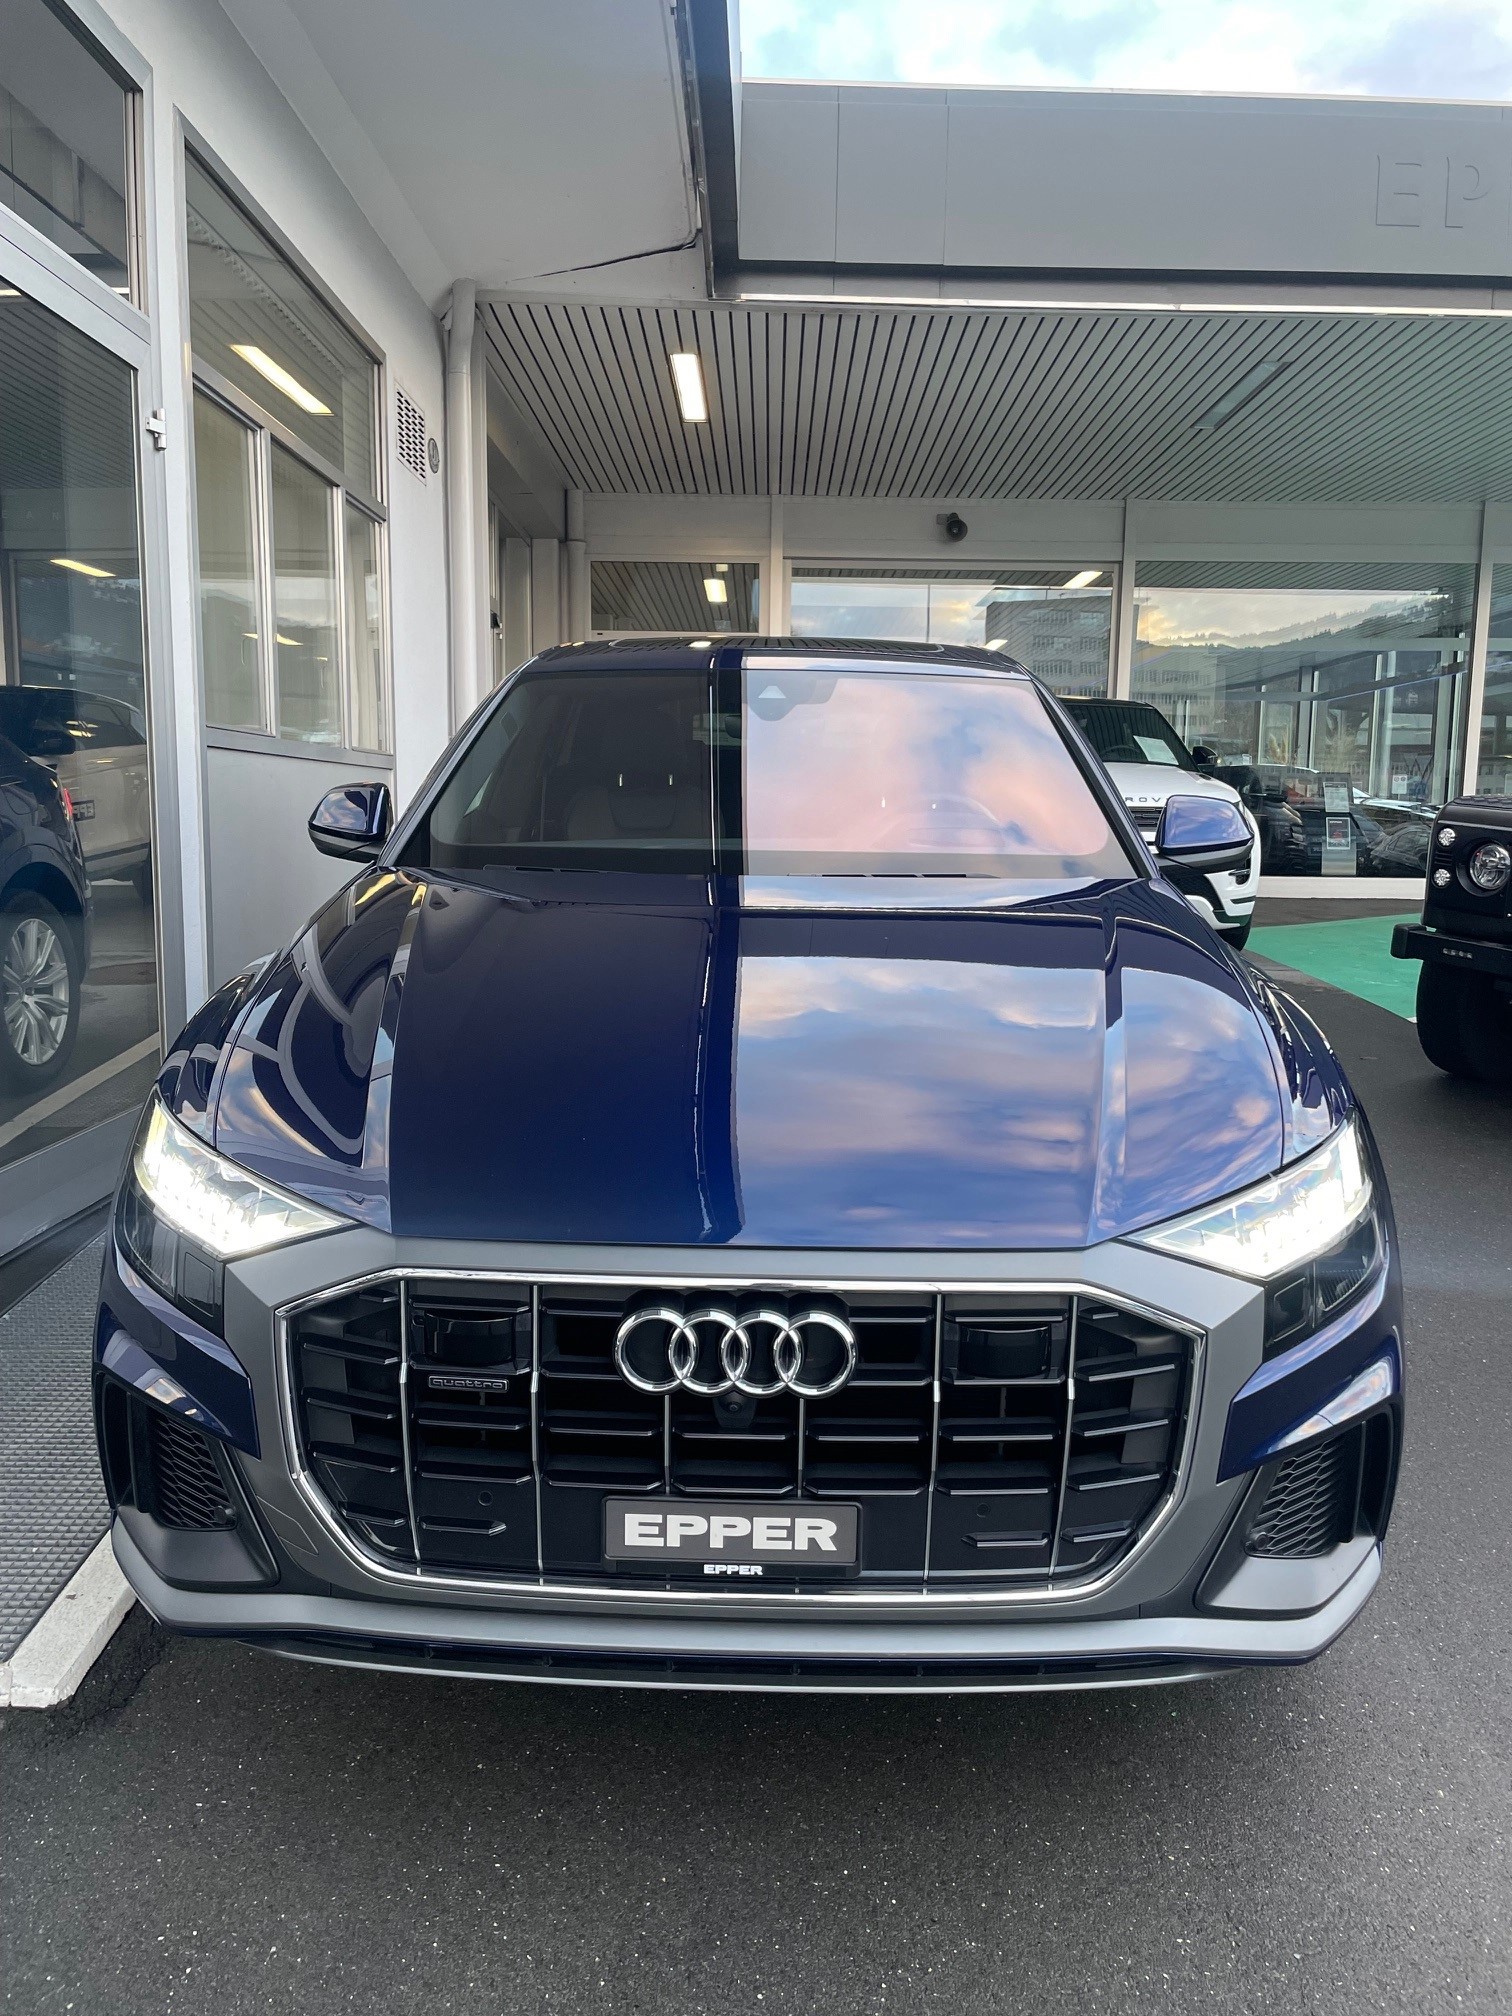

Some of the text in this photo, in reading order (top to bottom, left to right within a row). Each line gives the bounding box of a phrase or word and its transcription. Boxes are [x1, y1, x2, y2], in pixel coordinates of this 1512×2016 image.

[1376, 155, 1511, 229] EP
[432, 1379, 503, 1389] quattro
[624, 1513, 837, 1551] EPPER
[703, 1564, 763, 1576] EPPER
